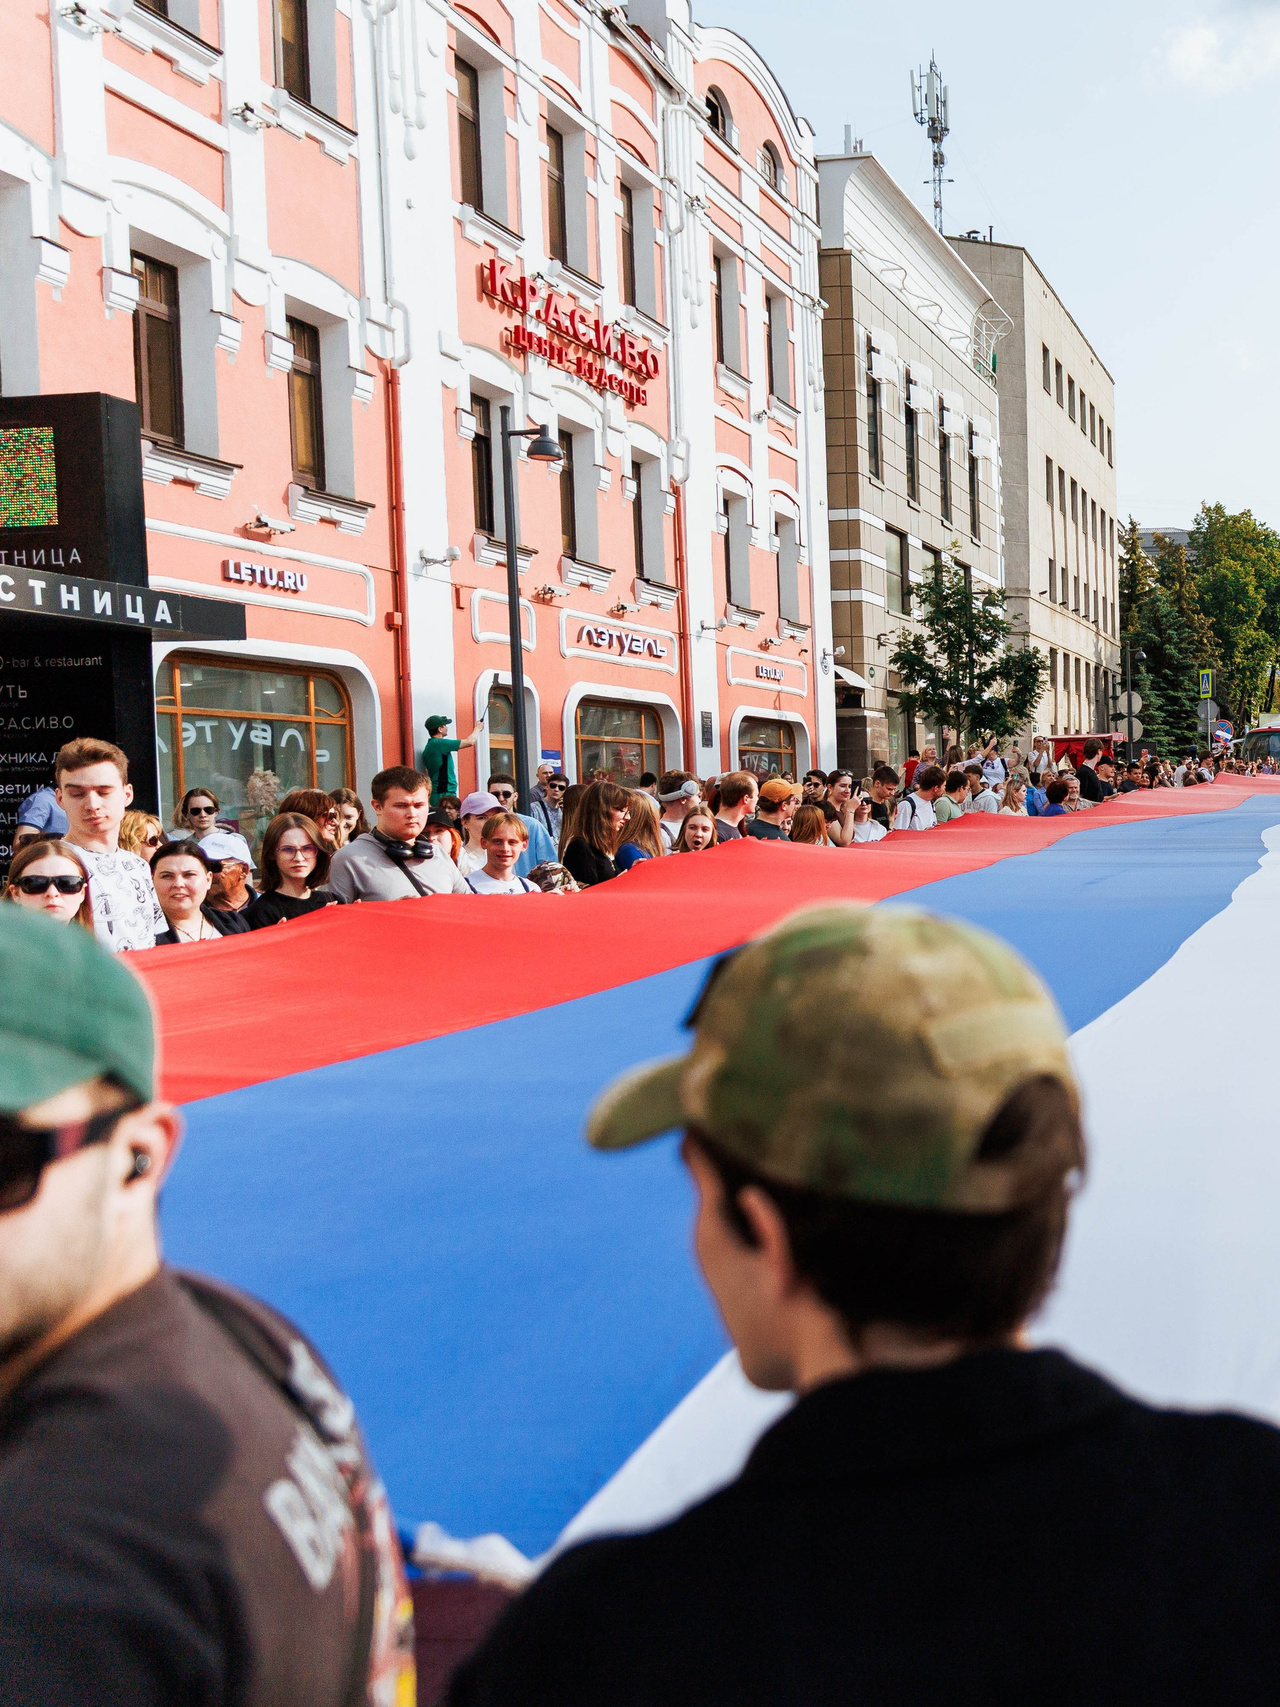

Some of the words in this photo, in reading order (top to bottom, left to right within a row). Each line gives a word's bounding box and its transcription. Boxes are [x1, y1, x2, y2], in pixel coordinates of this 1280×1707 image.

[513, 325, 570, 365] ЦЕНТР
[576, 356, 648, 406] КРАСОТЫ
[0, 547, 82, 567] ТНИЦА
[224, 559, 308, 592] LETU.RU
[0, 574, 173, 624] СТНИЦА
[45, 655, 103, 667] restaurant
[757, 665, 785, 681] LETU.RU
